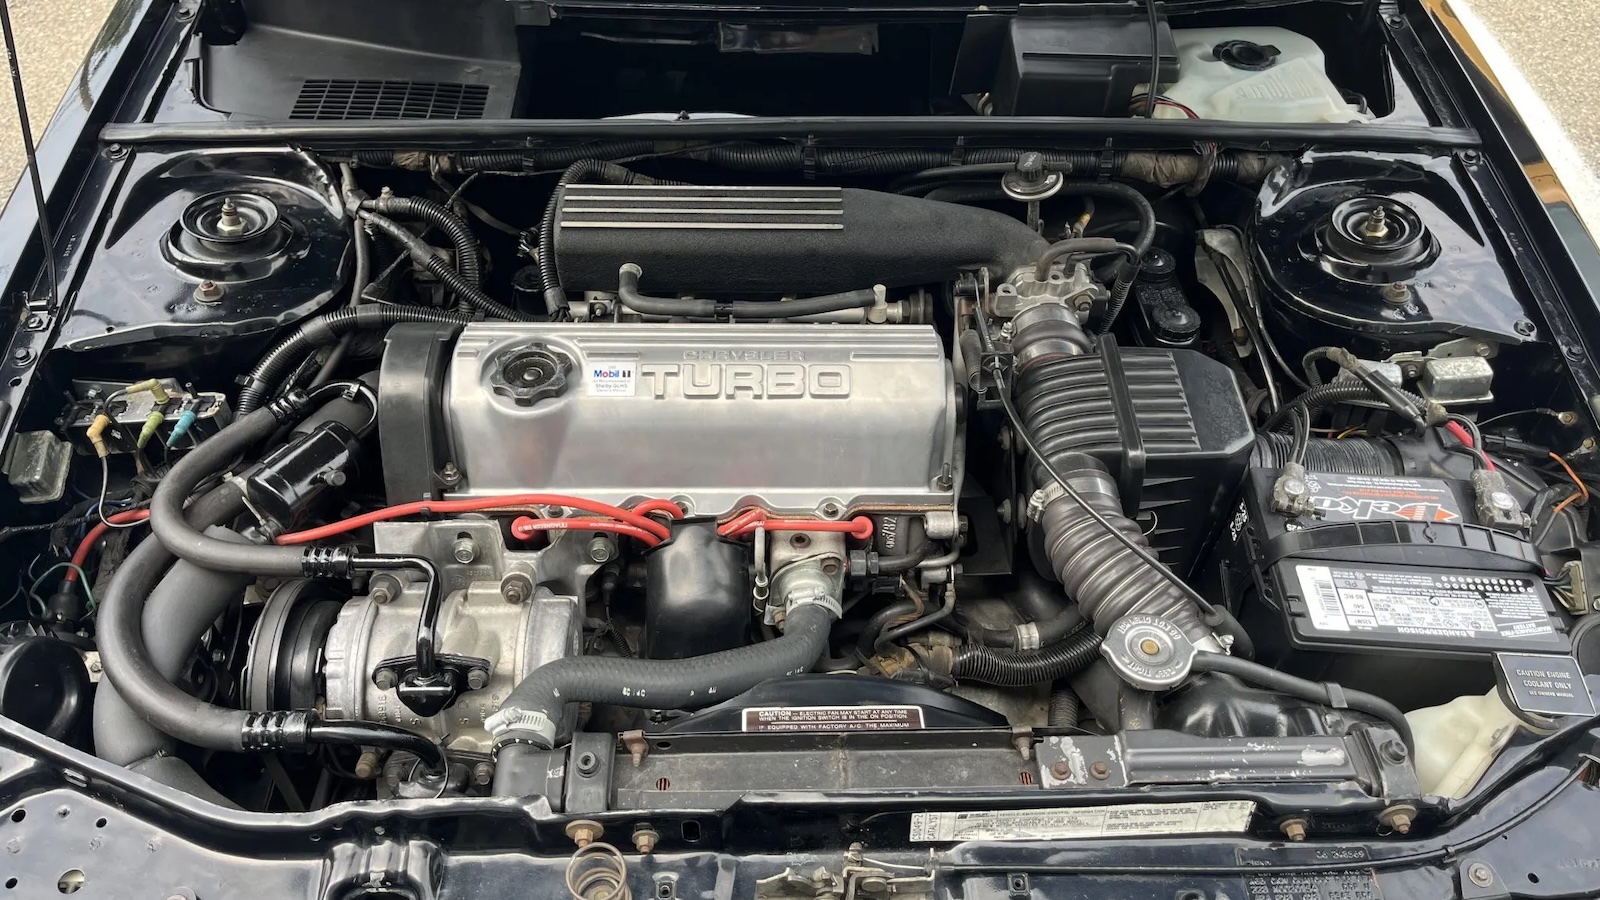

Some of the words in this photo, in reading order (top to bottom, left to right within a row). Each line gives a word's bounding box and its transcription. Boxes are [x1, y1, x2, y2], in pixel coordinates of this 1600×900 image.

[683, 350, 805, 361] CHRYSLER
[594, 369, 620, 378] Mobil
[641, 363, 850, 399] TURBO
[1344, 580, 1358, 588] Pb
[1397, 626, 1467, 637] DANGER/POISON
[1500, 625, 1552, 637] MAINTENANCE-FREE
[1513, 622, 1536, 630] BATTERY
[1127, 661, 1152, 677] TIGHT
[1516, 669, 1545, 677] CAUTION
[1546, 671, 1571, 679] ENGINE
[1523, 680, 1553, 688] COOLANT
[927, 814, 938, 840] CATALYST
